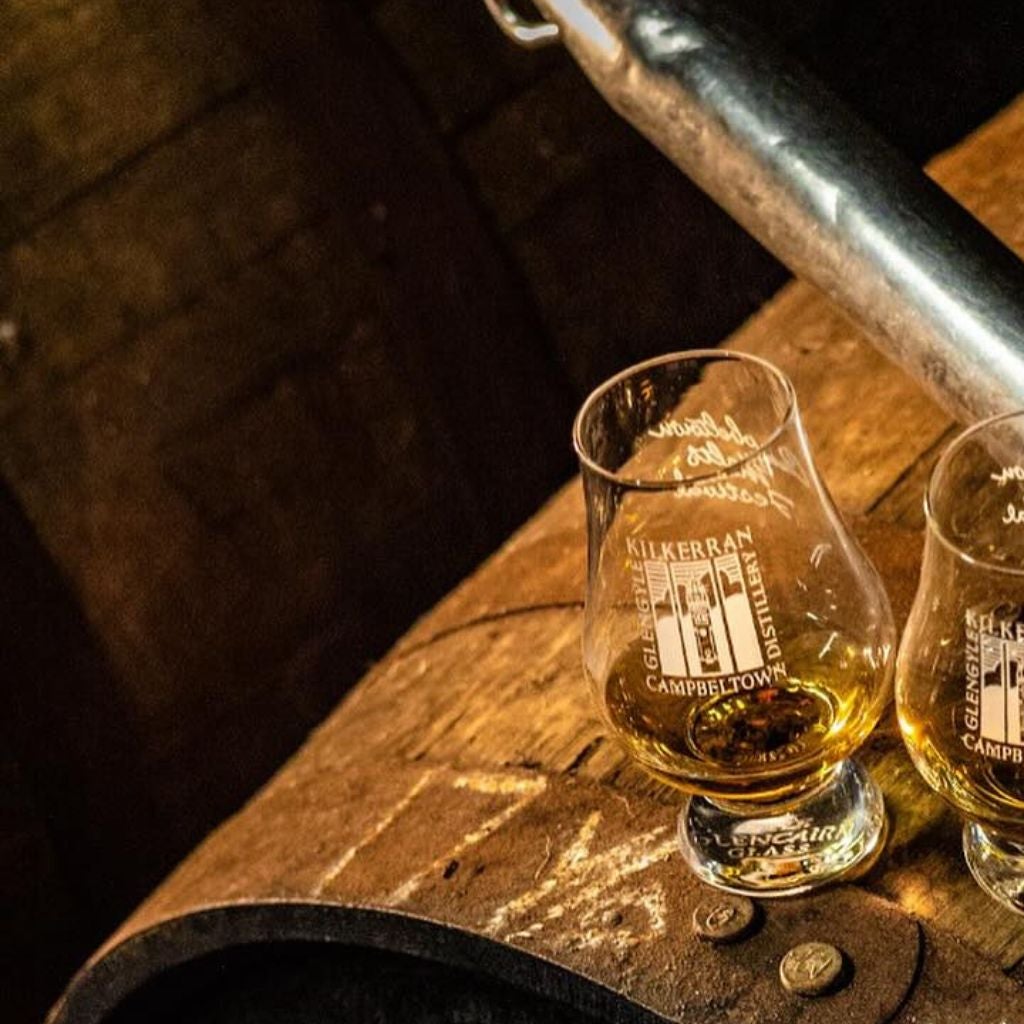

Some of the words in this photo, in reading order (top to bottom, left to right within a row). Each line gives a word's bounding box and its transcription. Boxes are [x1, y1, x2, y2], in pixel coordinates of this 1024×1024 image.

[626, 525, 753, 561] KILKERRAN
[631, 559, 659, 671] GLENGYLE
[741, 550, 782, 661] DISTILLERY
[645, 661, 788, 697] CAMPBELTOWN
[964, 626, 980, 732] GLENGYLE
